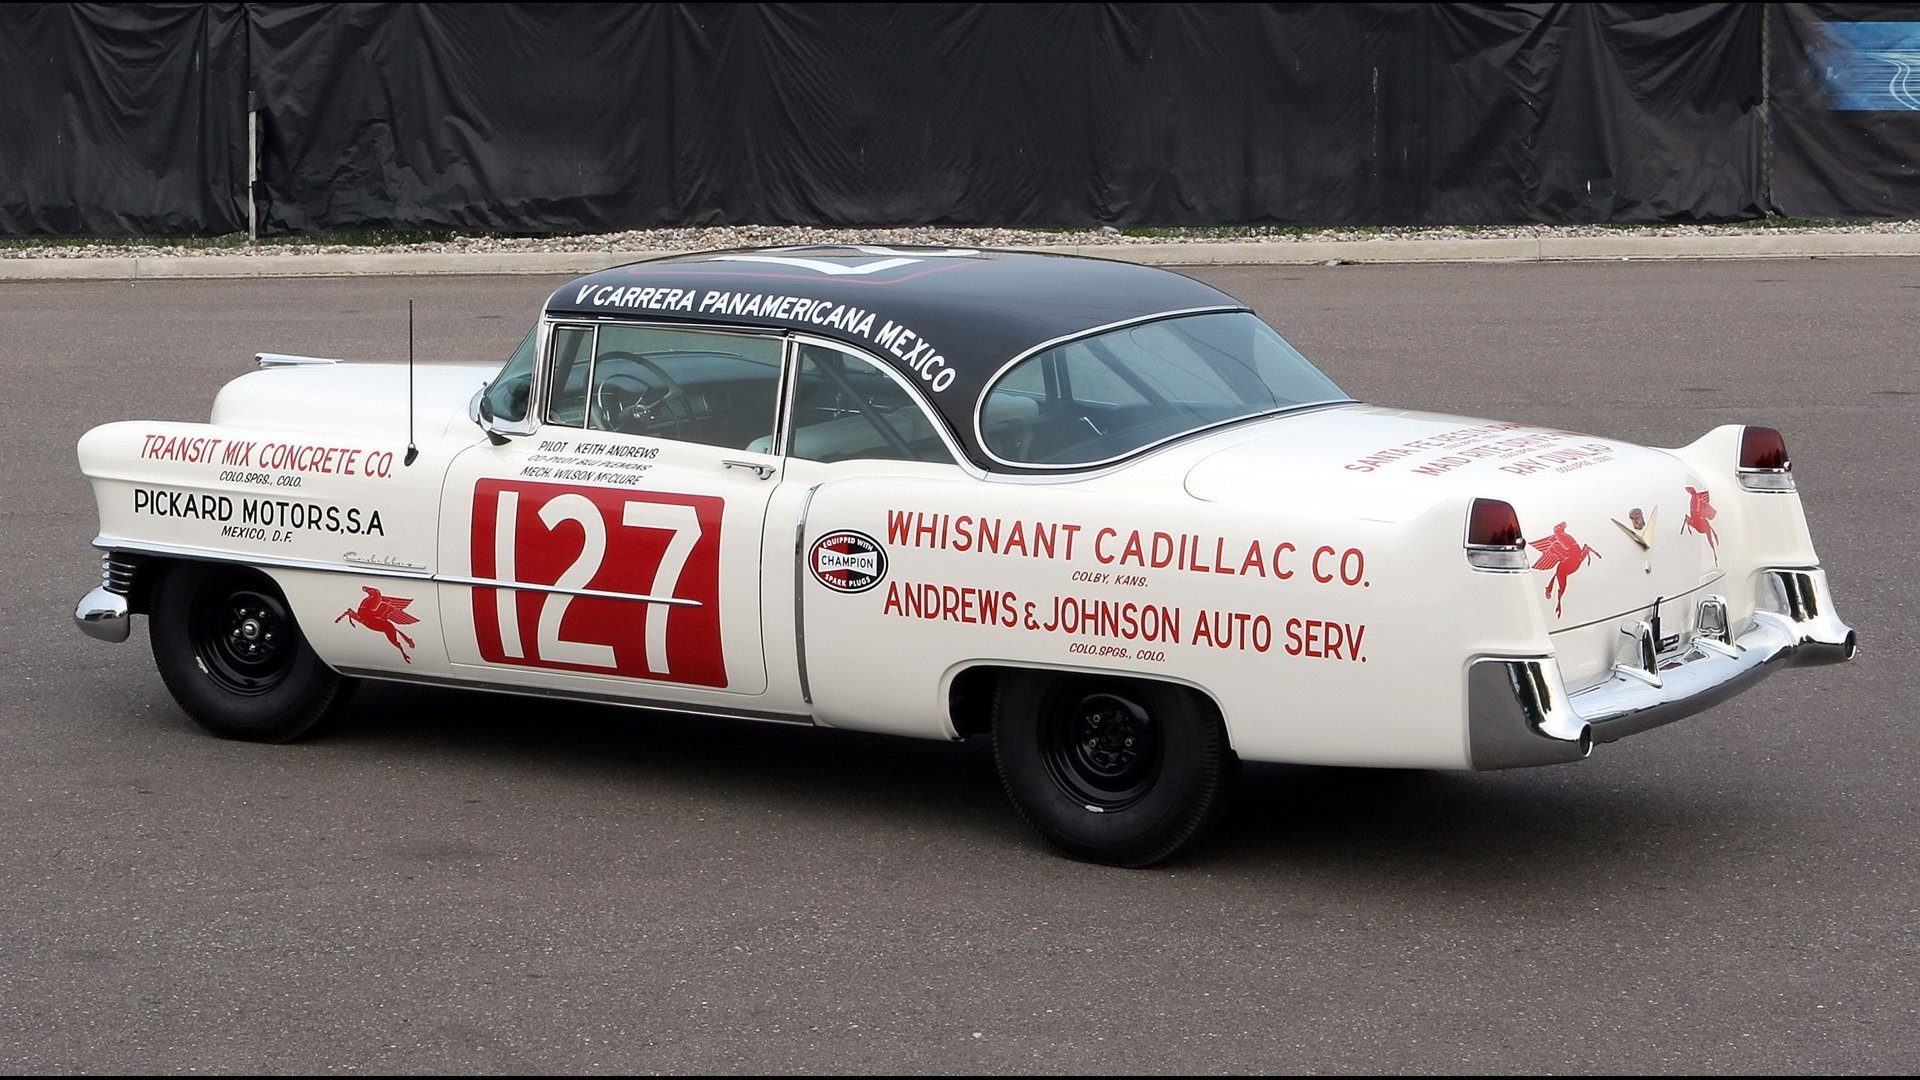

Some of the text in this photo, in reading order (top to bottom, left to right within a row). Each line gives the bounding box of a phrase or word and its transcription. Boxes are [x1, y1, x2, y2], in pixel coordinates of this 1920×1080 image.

[576, 285, 957, 393] V CARRERA PANAMERICANA MEXICO
[141, 435, 393, 479] TRANSIT MIX CONCRETE CO.
[538, 440, 659, 459] PILOT KEITH ANDREWS
[1498, 458, 1551, 475] RAY
[1536, 443, 1614, 464] DUNLAP
[528, 454, 578, 465] CO-PILOT
[1344, 449, 1420, 472] SANTA
[1411, 457, 1472, 476] MAID
[276, 475, 302, 488] COLO.
[520, 466, 644, 485] MECH. WILSON McCLURE
[134, 489, 233, 522] PICKARD
[221, 525, 293, 543] MEXICO, D.F.
[823, 537, 874, 551] EQUIPPED WITH
[888, 510, 1370, 587] WHISNANT CADILLAC CO.
[821, 555, 874, 568] CHAMPION
[494, 490, 702, 675] 127
[825, 574, 870, 587] SPARK PLUGS
[1072, 571, 1149, 588] COLBY, KANS.
[884, 581, 1018, 628] ANDREWS
[1043, 597, 1180, 644] JOHNSON
[1192, 610, 1272, 653] AUTO
[1284, 618, 1367, 663] SERV.
[1136, 650, 1166, 662] COLO.
